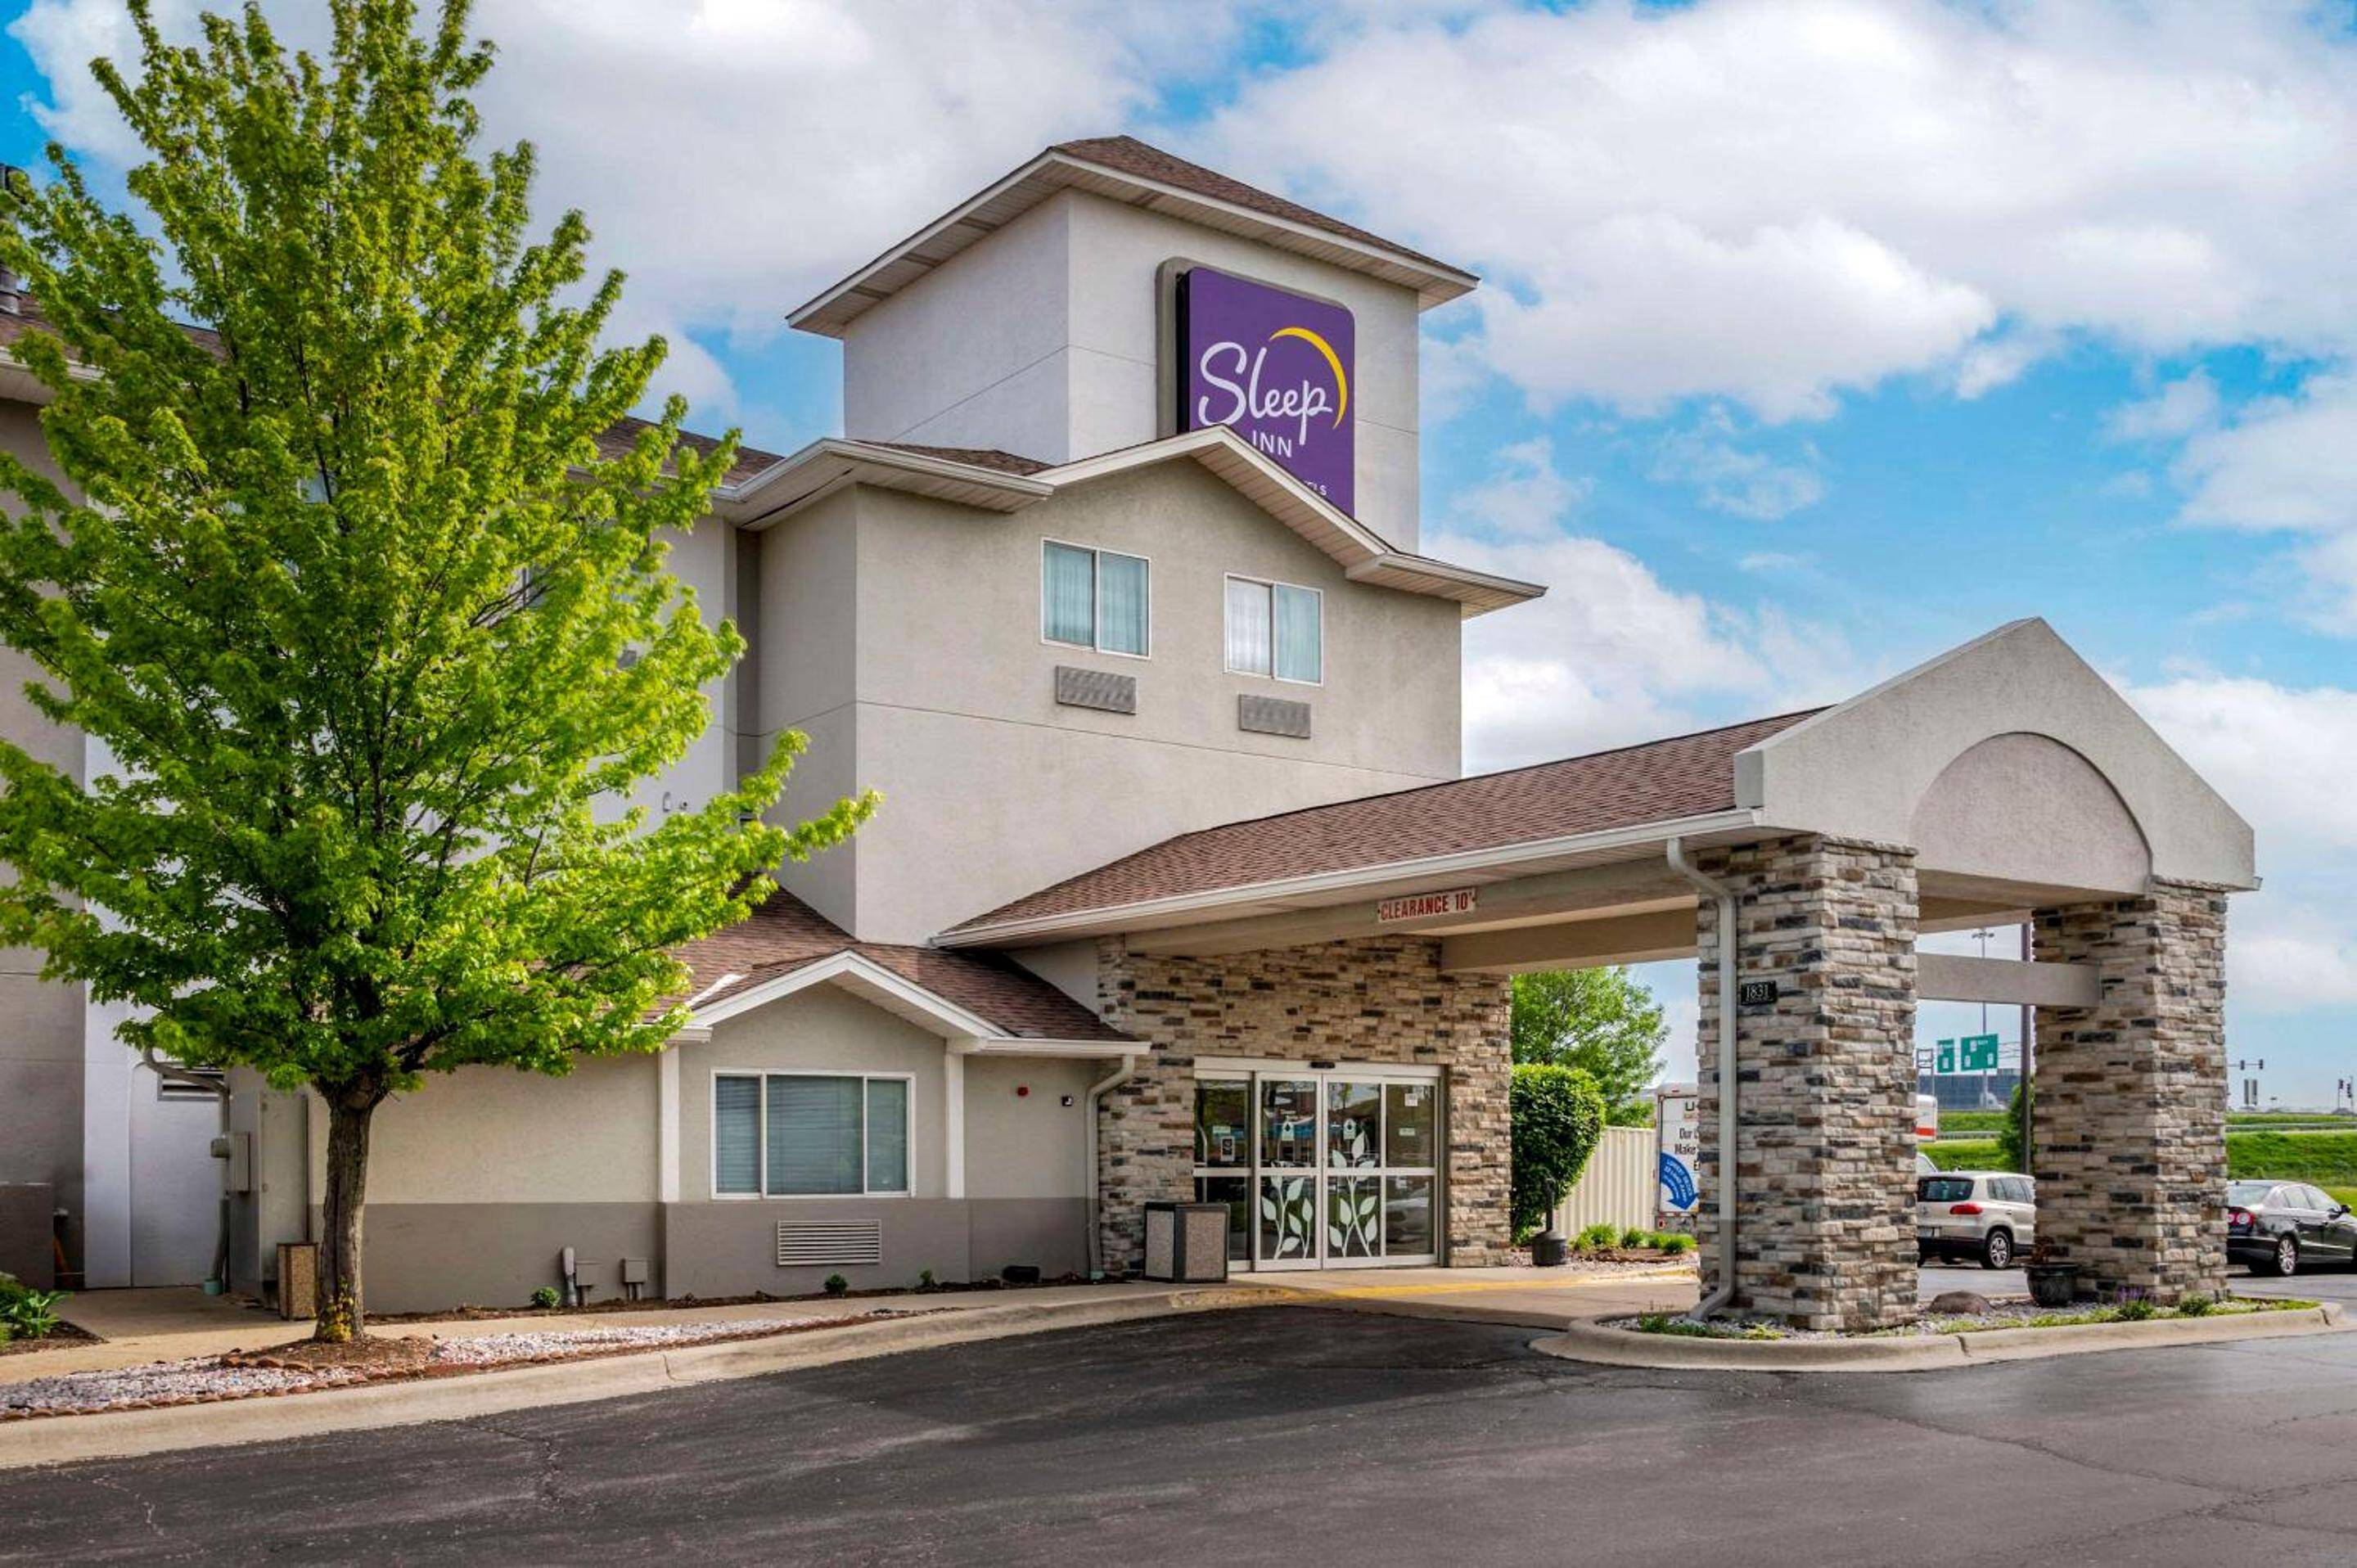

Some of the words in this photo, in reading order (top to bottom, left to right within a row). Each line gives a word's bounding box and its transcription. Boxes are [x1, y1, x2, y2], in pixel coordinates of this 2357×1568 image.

[1198, 341, 1332, 445] Sleep
[1252, 430, 1291, 457] INN
[1381, 895, 1448, 920] CLEARANCE
